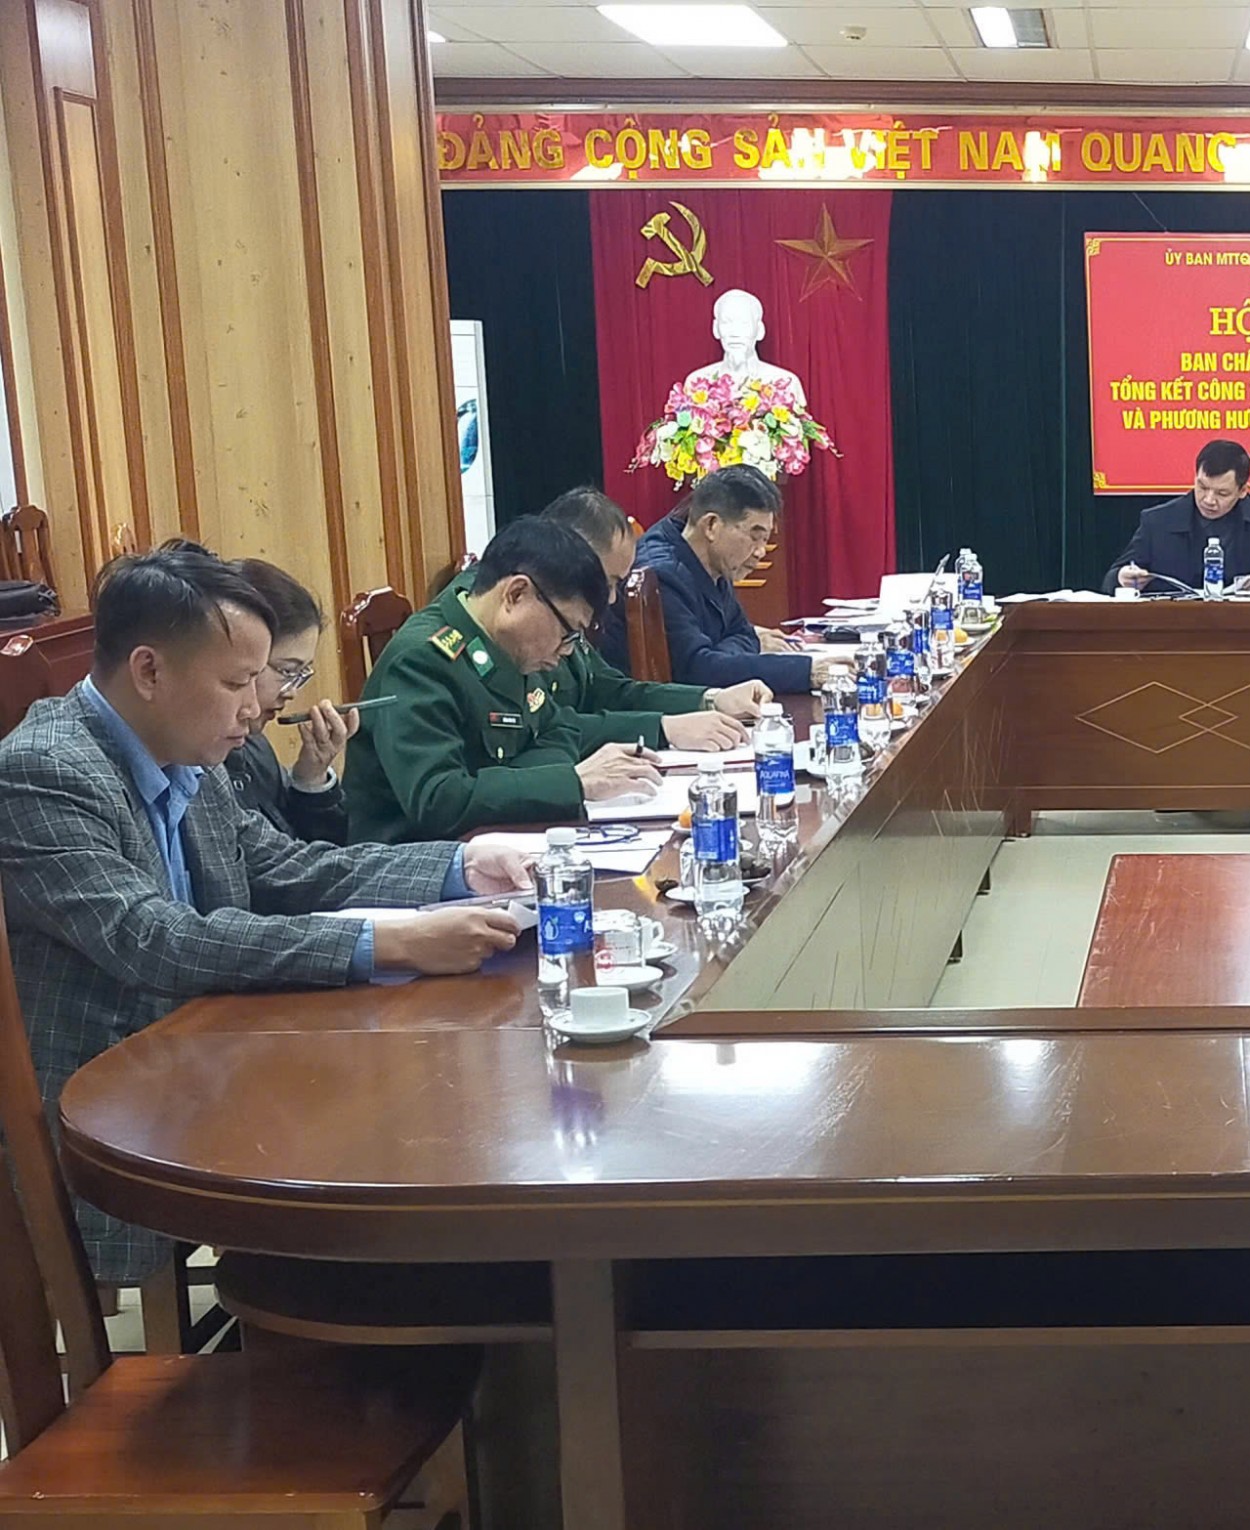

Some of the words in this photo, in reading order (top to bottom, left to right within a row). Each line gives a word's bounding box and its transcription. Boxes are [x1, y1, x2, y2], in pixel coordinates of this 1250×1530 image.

[437, 112, 565, 170] ĐẢNG
[584, 117, 713, 179] CỘNG
[841, 120, 939, 180] VIỆT
[959, 130, 1061, 172] NAM
[1165, 247, 1182, 266] ỦY
[1185, 252, 1213, 266] BAN
[1181, 352, 1217, 372] BAN
[1110, 375, 1156, 401] TỔNG
[1161, 376, 1193, 401] KẾT
[1198, 378, 1245, 400] CÔNG
[1122, 407, 1146, 430] VÀ
[1150, 408, 1221, 430] PHƯƠNG
